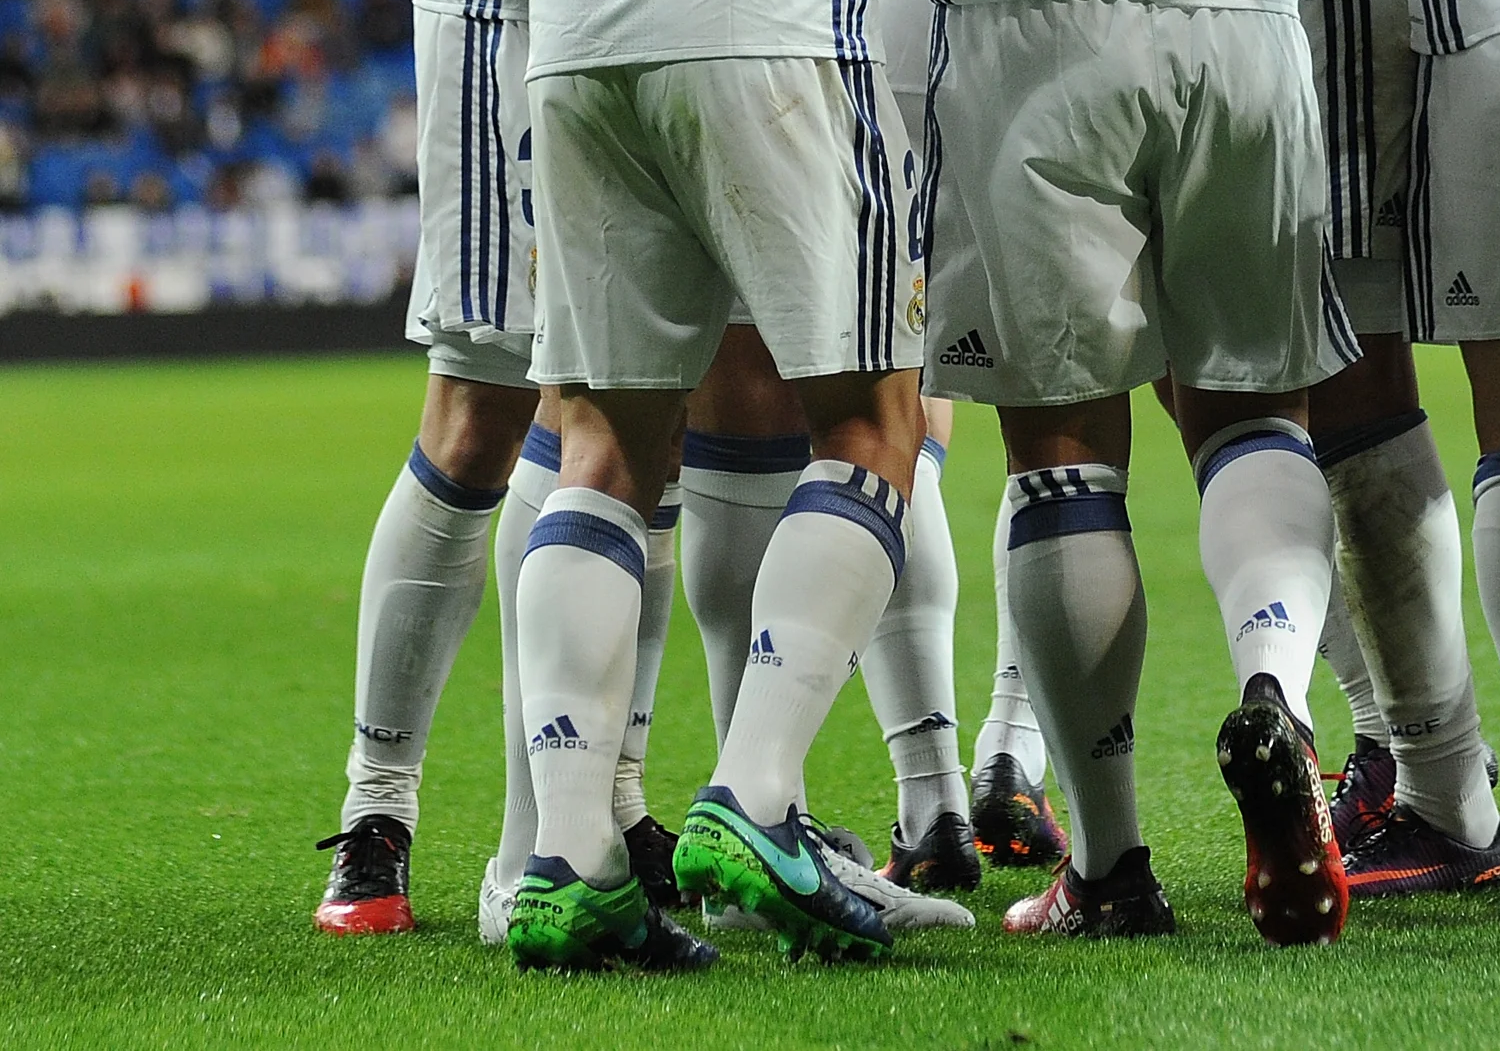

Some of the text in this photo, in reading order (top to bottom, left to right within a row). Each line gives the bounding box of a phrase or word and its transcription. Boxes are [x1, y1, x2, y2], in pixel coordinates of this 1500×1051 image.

[1446, 292, 1480, 306] adidas
[939, 351, 994, 369] adidas
[1235, 616, 1297, 642] adidas
[1388, 717, 1442, 737] MCF
[528, 735, 589, 758] adidas
[1305, 757, 1333, 844] adidas
